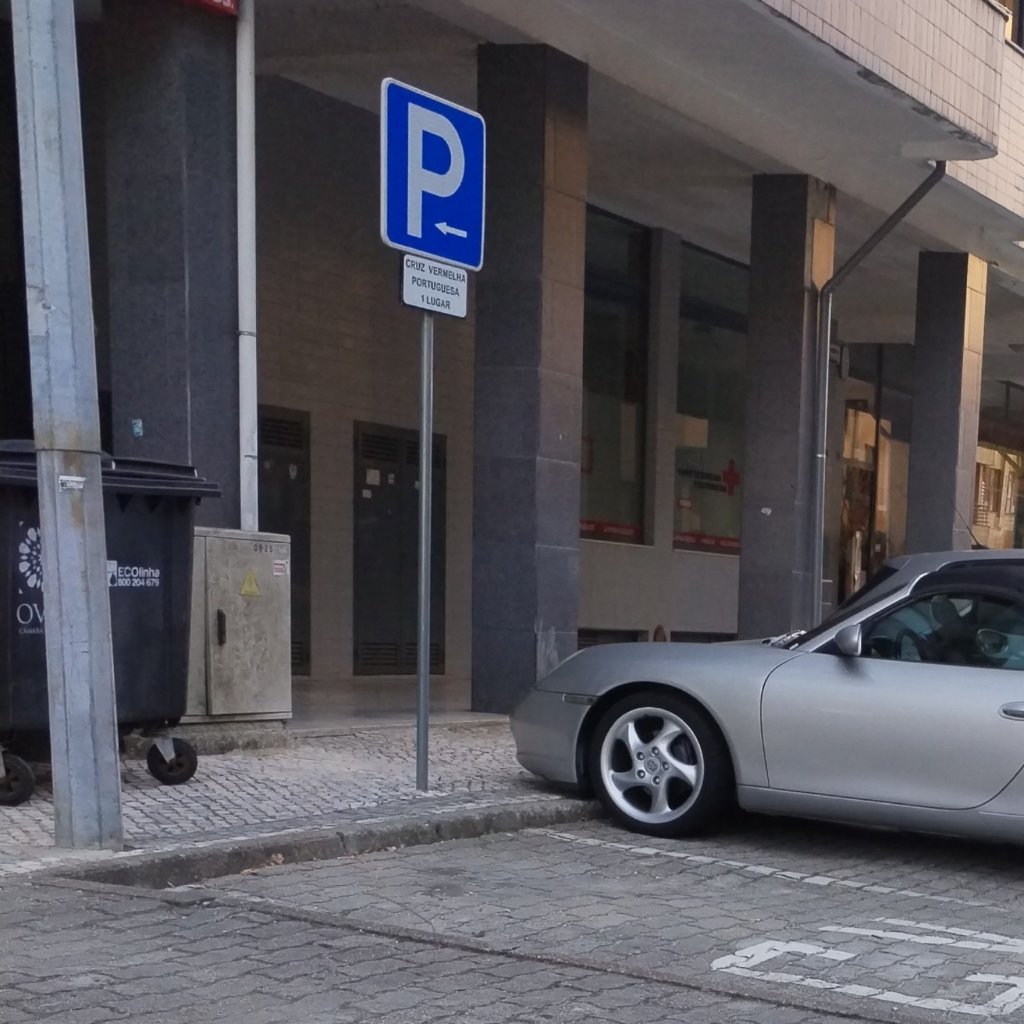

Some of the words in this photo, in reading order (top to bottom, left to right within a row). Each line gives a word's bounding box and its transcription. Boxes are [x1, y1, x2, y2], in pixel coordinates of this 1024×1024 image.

[407, 102, 465, 238] P
[405, 258, 426, 273] CRUZ
[428, 265, 466, 284] VERMELHA
[411, 276, 460, 297] PORTUGUESA
[426, 296, 451, 310] LUGAR
[117, 566, 160, 577] ECOlinha
[117, 577, 131, 586] 800
[132, 578, 145, 587] 204
[146, 578, 160, 587] 679
[16, 602, 46, 625] OV
